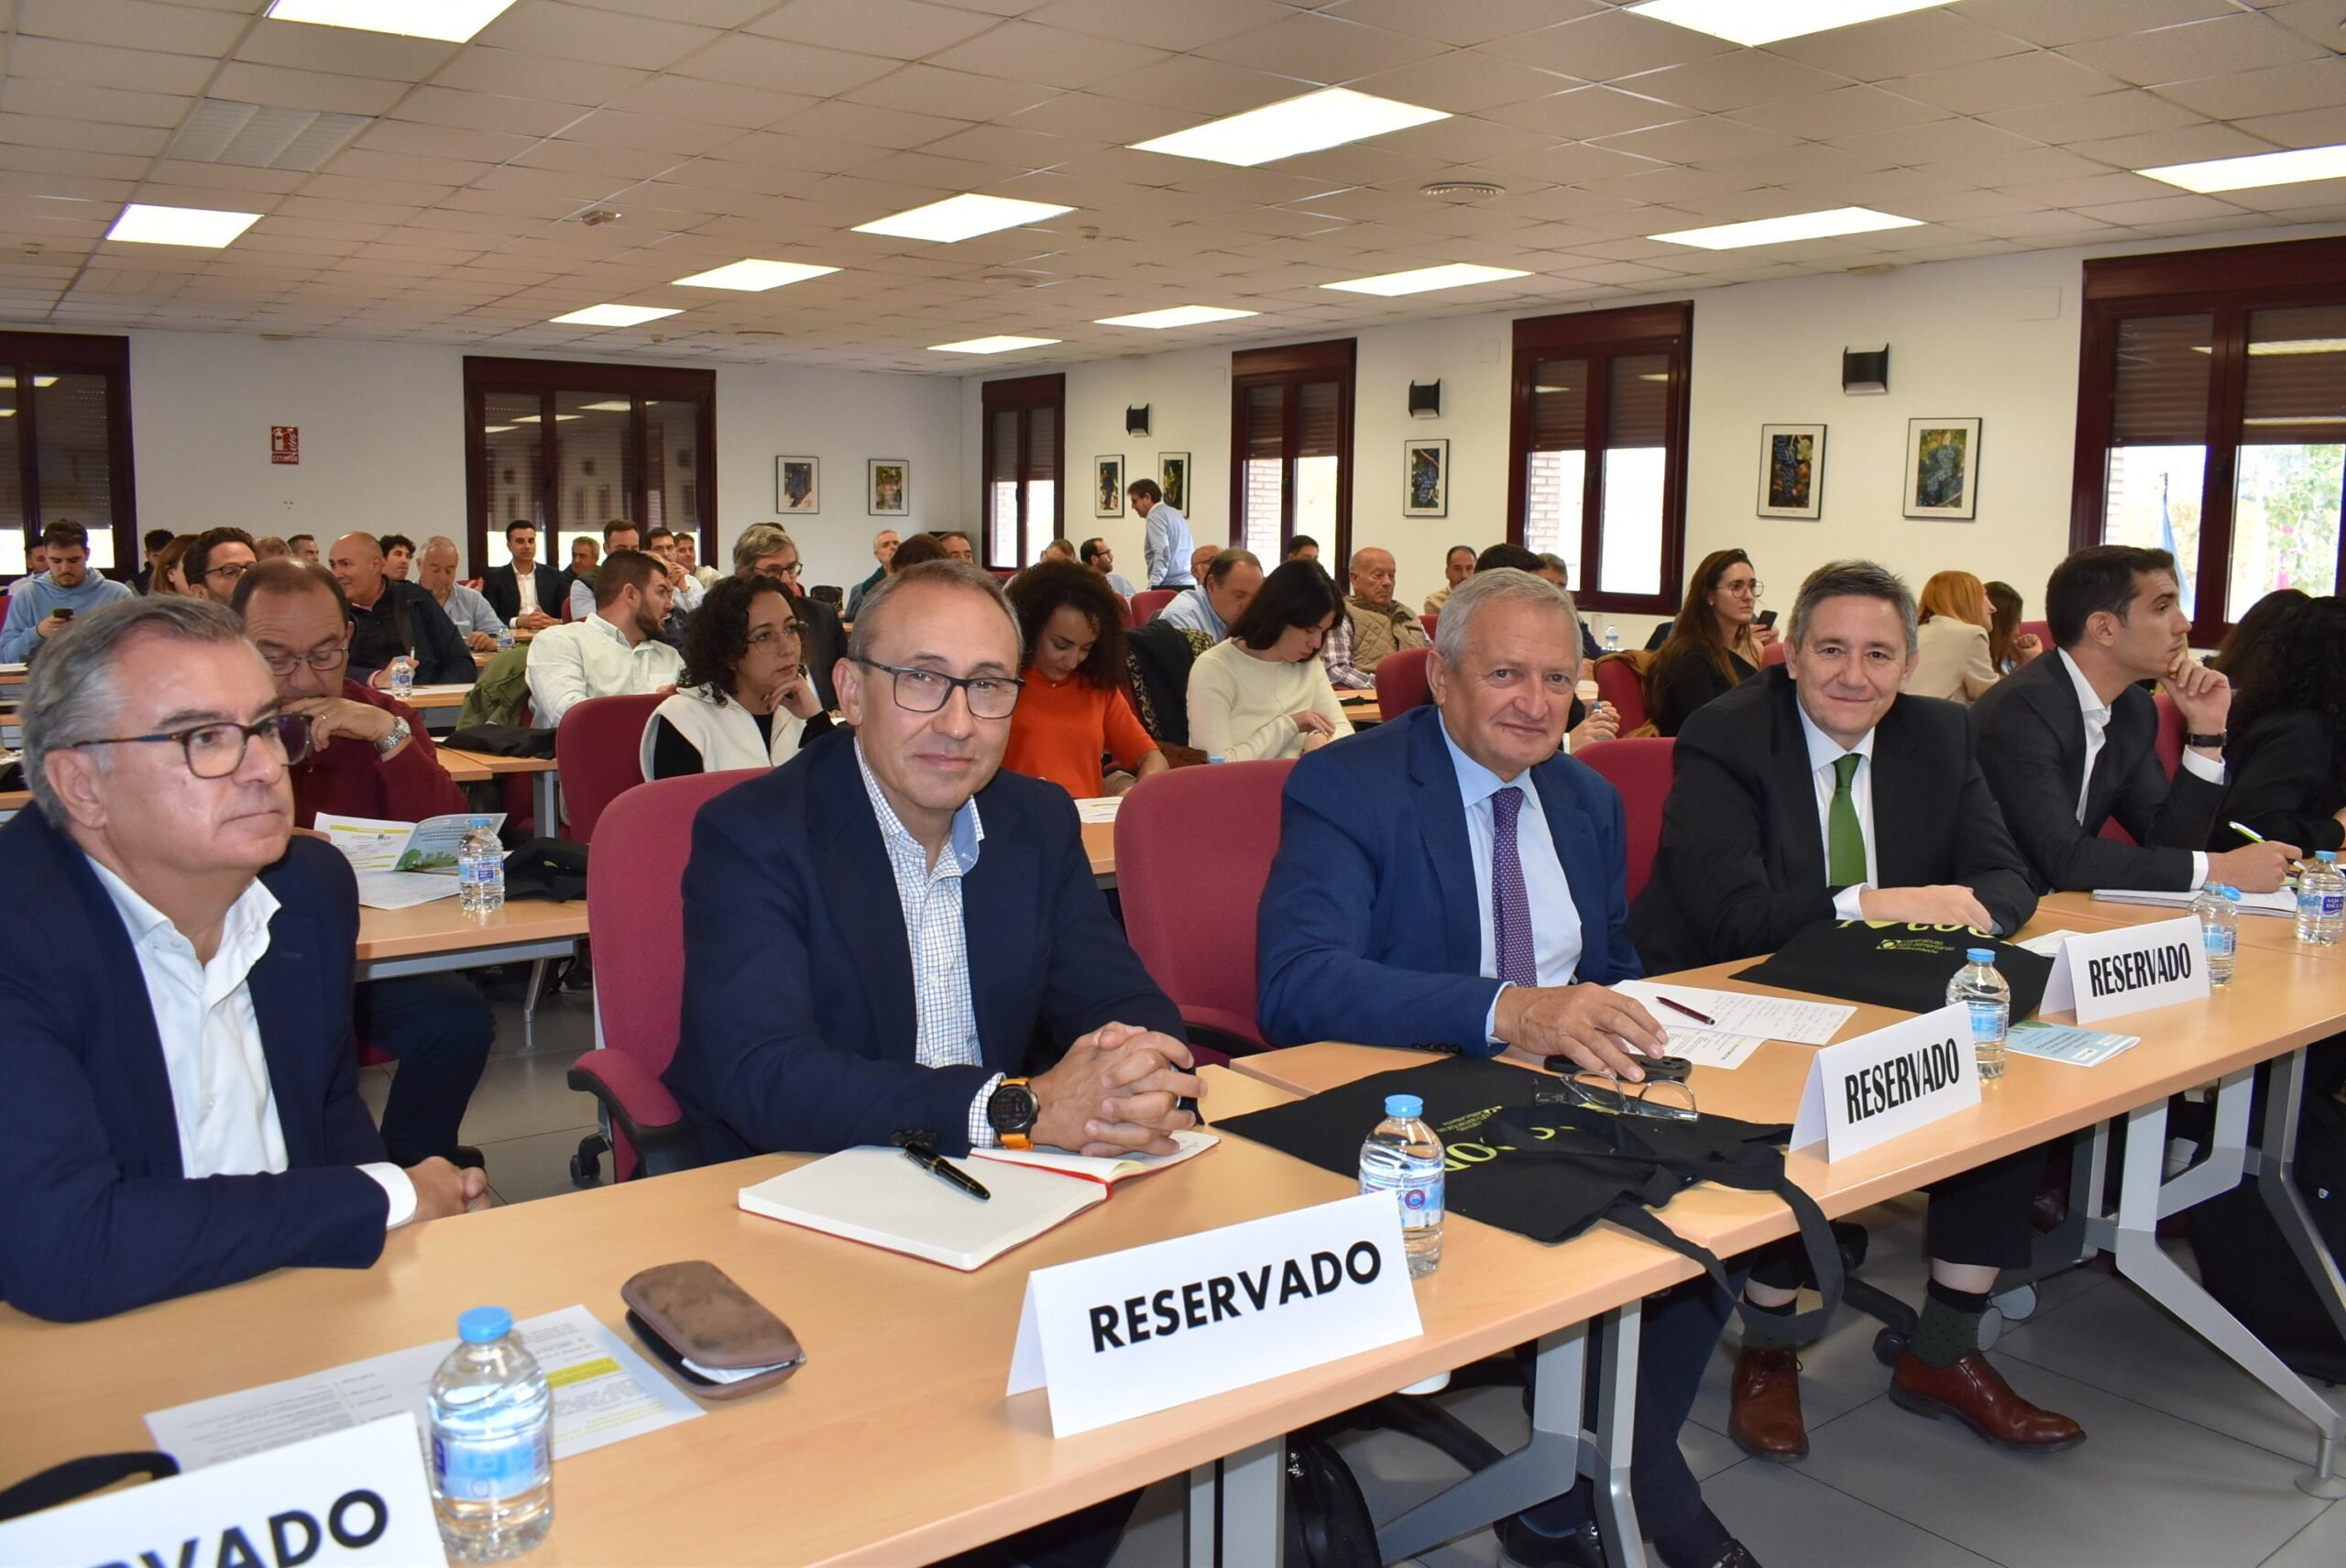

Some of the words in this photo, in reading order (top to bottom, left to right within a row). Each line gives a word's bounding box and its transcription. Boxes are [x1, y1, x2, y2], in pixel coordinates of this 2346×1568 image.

[2088, 942, 2191, 997] RESERVADO
[1845, 1037, 1959, 1124] RESERVADO
[1089, 1240, 1382, 1354] RESERVADO
